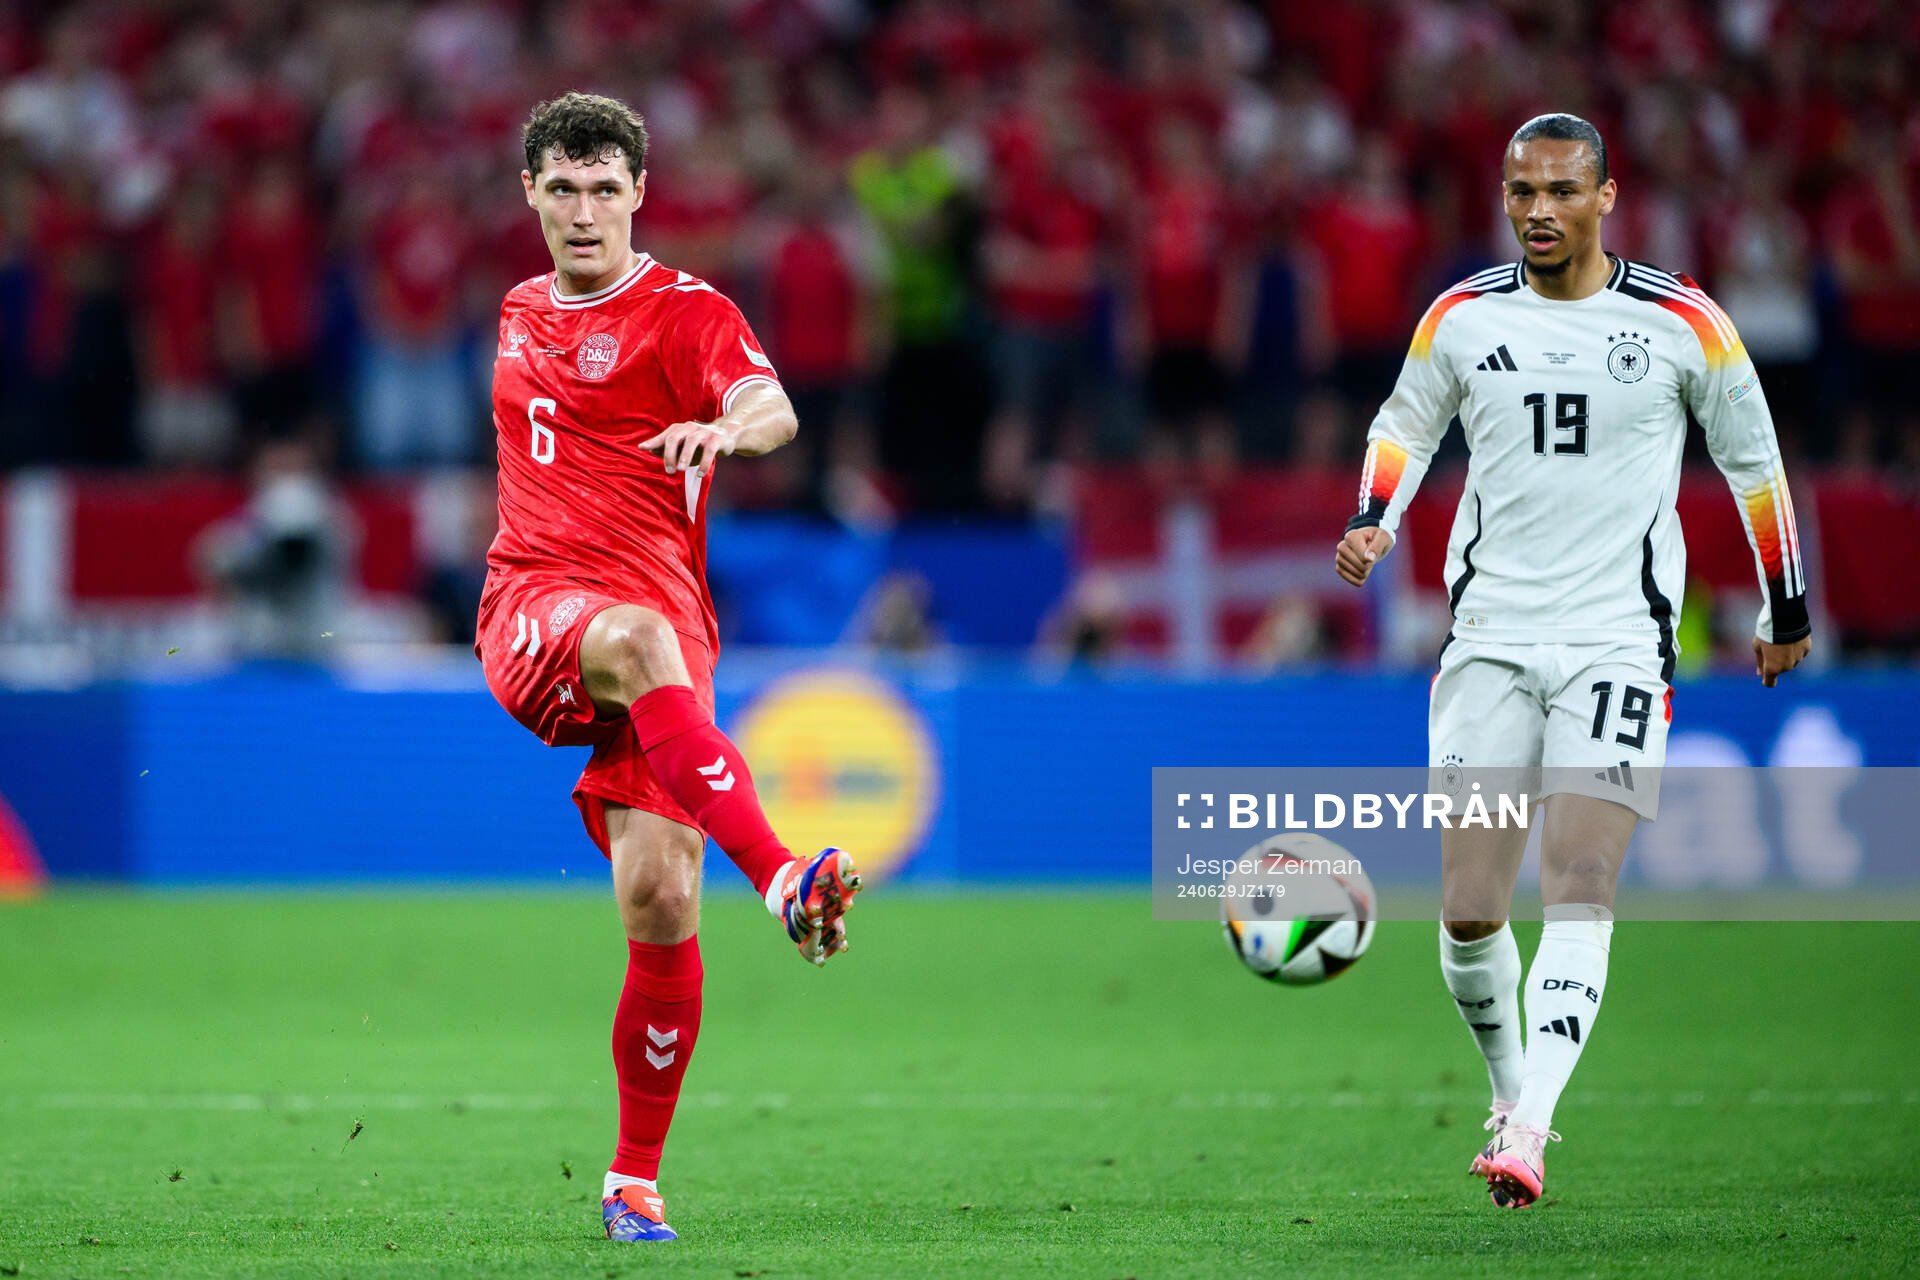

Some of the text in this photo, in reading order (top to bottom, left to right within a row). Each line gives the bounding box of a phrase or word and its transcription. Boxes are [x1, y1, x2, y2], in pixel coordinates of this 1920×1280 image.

[586, 348, 611, 362] DBU
[527, 397, 557, 465] 6
[1523, 393, 1590, 457] 19
[1590, 681, 1654, 754] 19
[1543, 979, 1599, 1004] DFB
